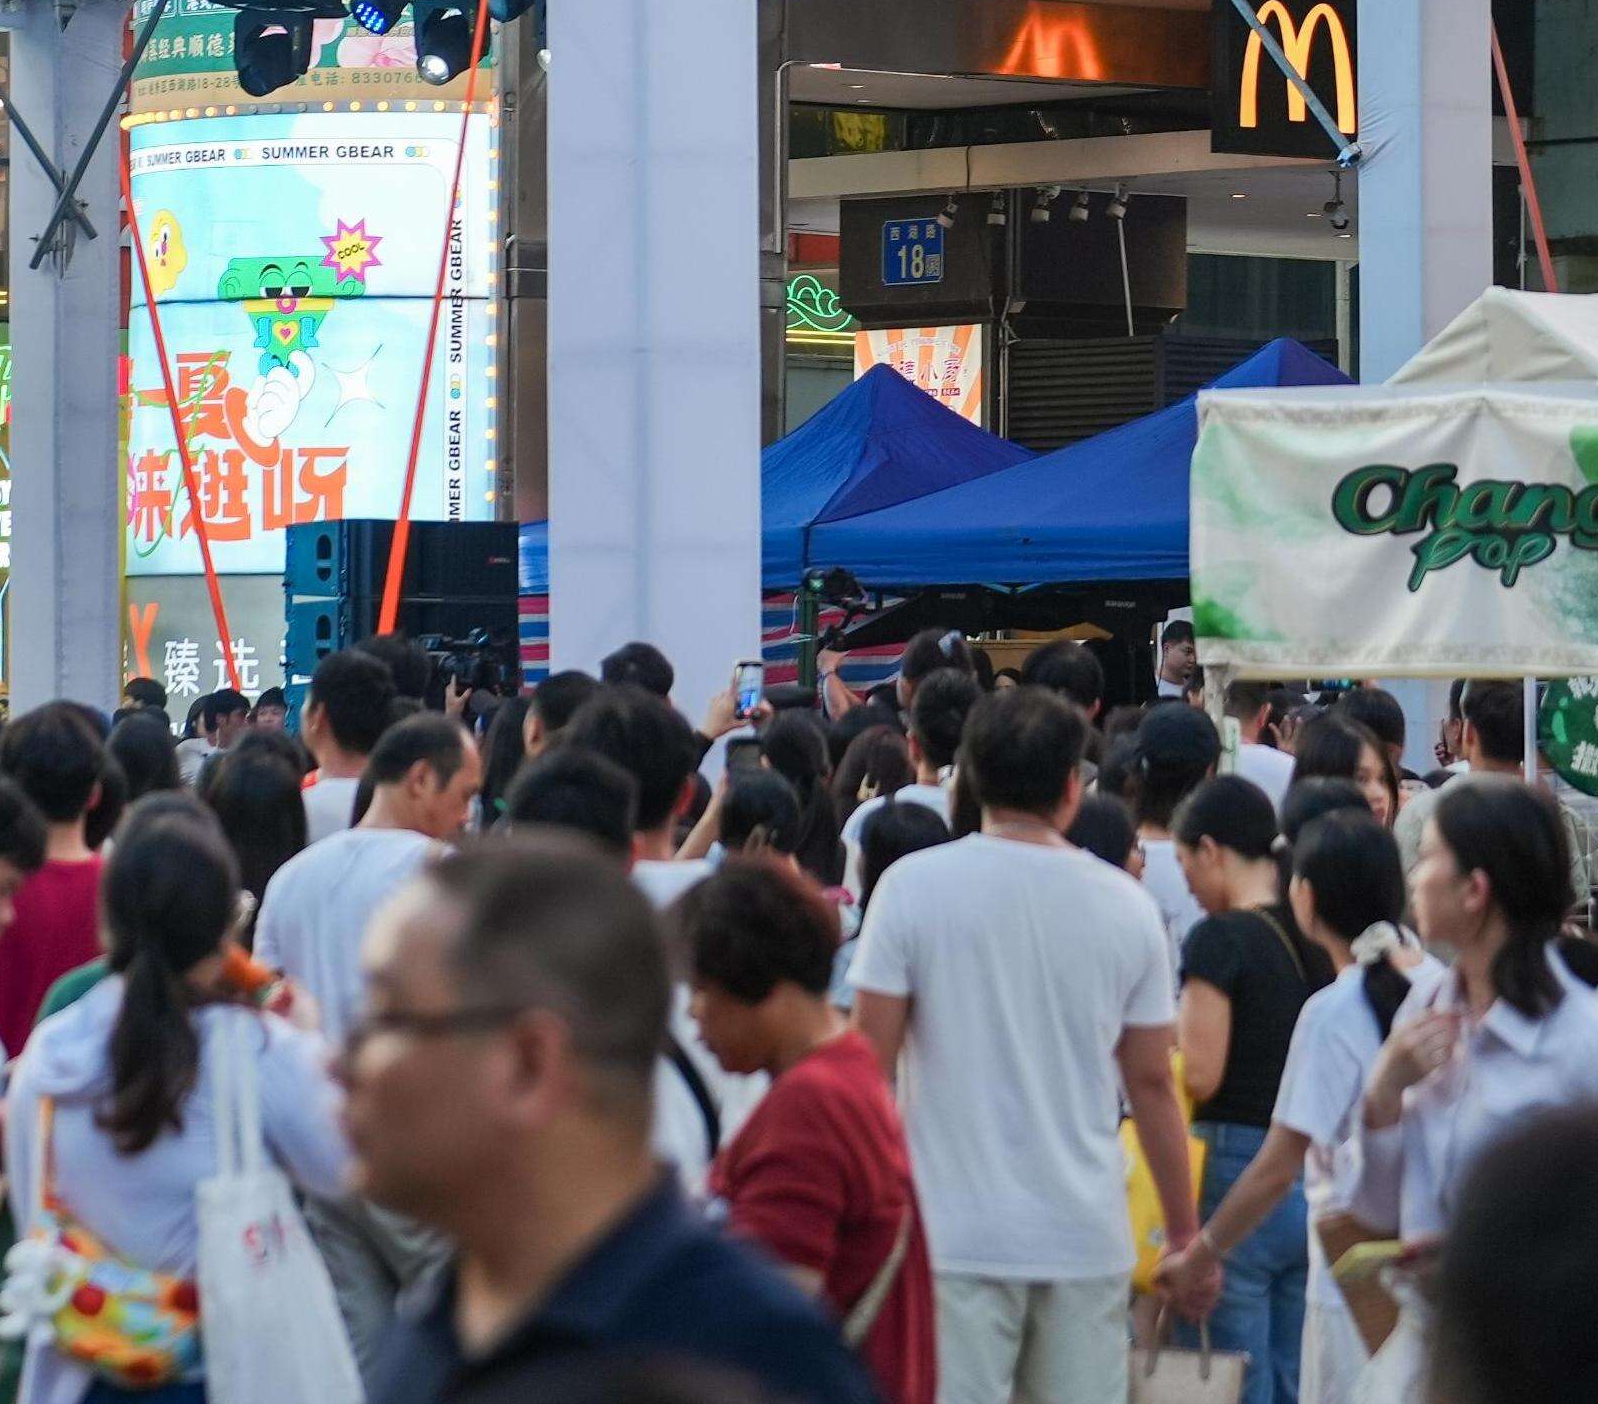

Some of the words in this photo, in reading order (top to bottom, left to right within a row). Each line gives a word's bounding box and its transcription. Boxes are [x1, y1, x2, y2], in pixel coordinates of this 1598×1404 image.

[146, 151, 182, 166] SUMMER
[185, 147, 226, 163] GBEAR
[261, 145, 330, 160] SUMMER
[335, 144, 395, 159] GBEAR
[338, 243, 365, 261] COOL
[450, 218, 463, 282] GBEAR
[897, 244, 925, 279] 18
[450, 287, 463, 364] SUMMER
[449, 409, 462, 472] GBEAR
